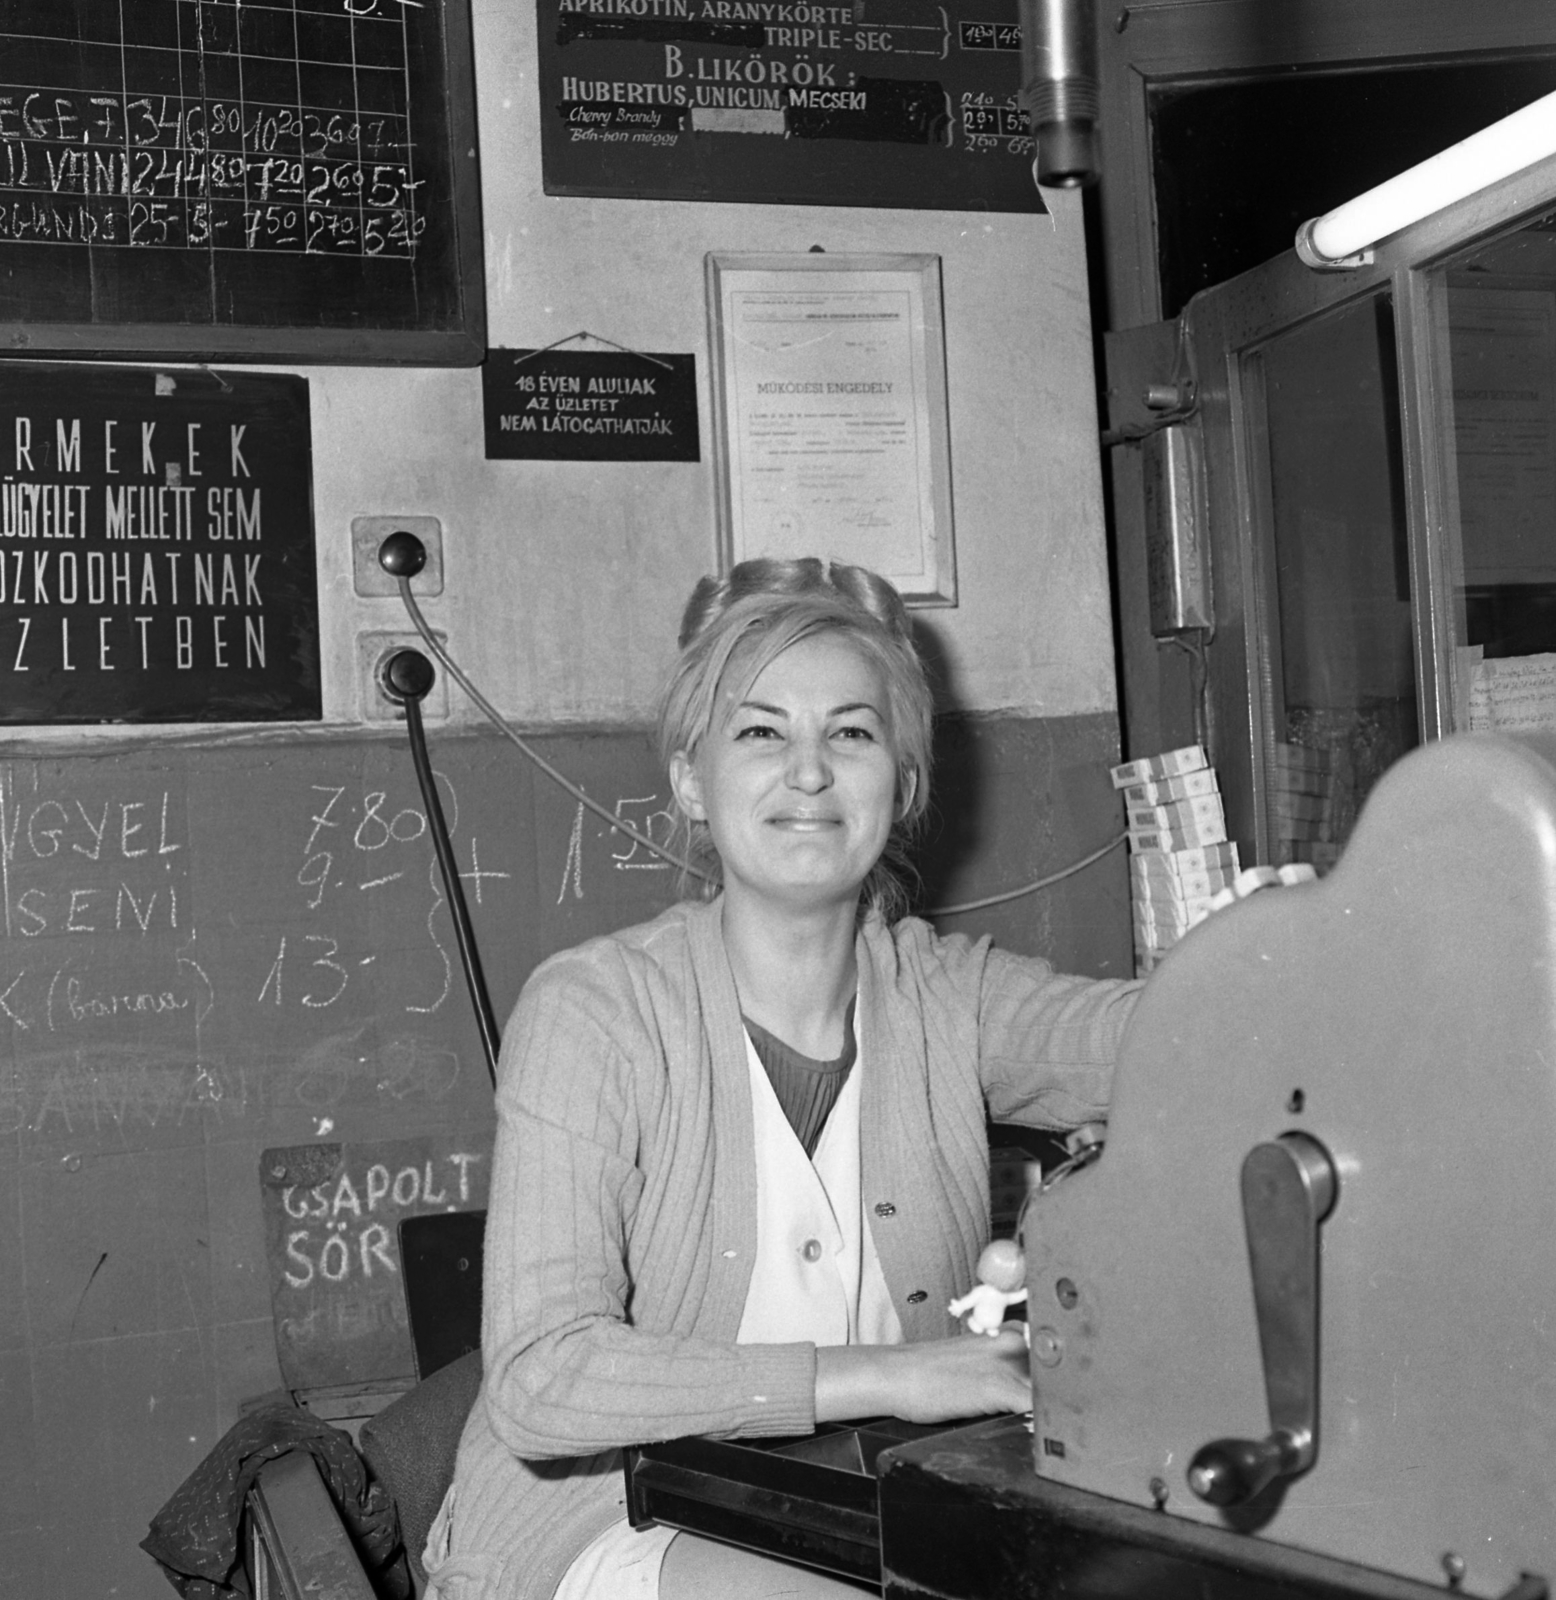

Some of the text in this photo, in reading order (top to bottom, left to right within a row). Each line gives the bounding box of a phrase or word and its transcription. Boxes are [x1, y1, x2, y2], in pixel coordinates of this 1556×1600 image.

[558, 0, 852, 25] APRIKOTIN, ARANYKÖRTE
[764, 27, 892, 51] TRIPLE-SEC
[616, 107, 661, 128] Brandy
[514, 370, 656, 395] 18 ÉVEN ALULIAK
[525, 396, 550, 411] AZ
[500, 411, 673, 435] NEM LÁTOGATHATJÁK
[0, 475, 262, 541] ÜGYELET MELLETT SEM
[13, 615, 266, 671] ZLETBEN
[284, 1220, 398, 1289] SÖR
